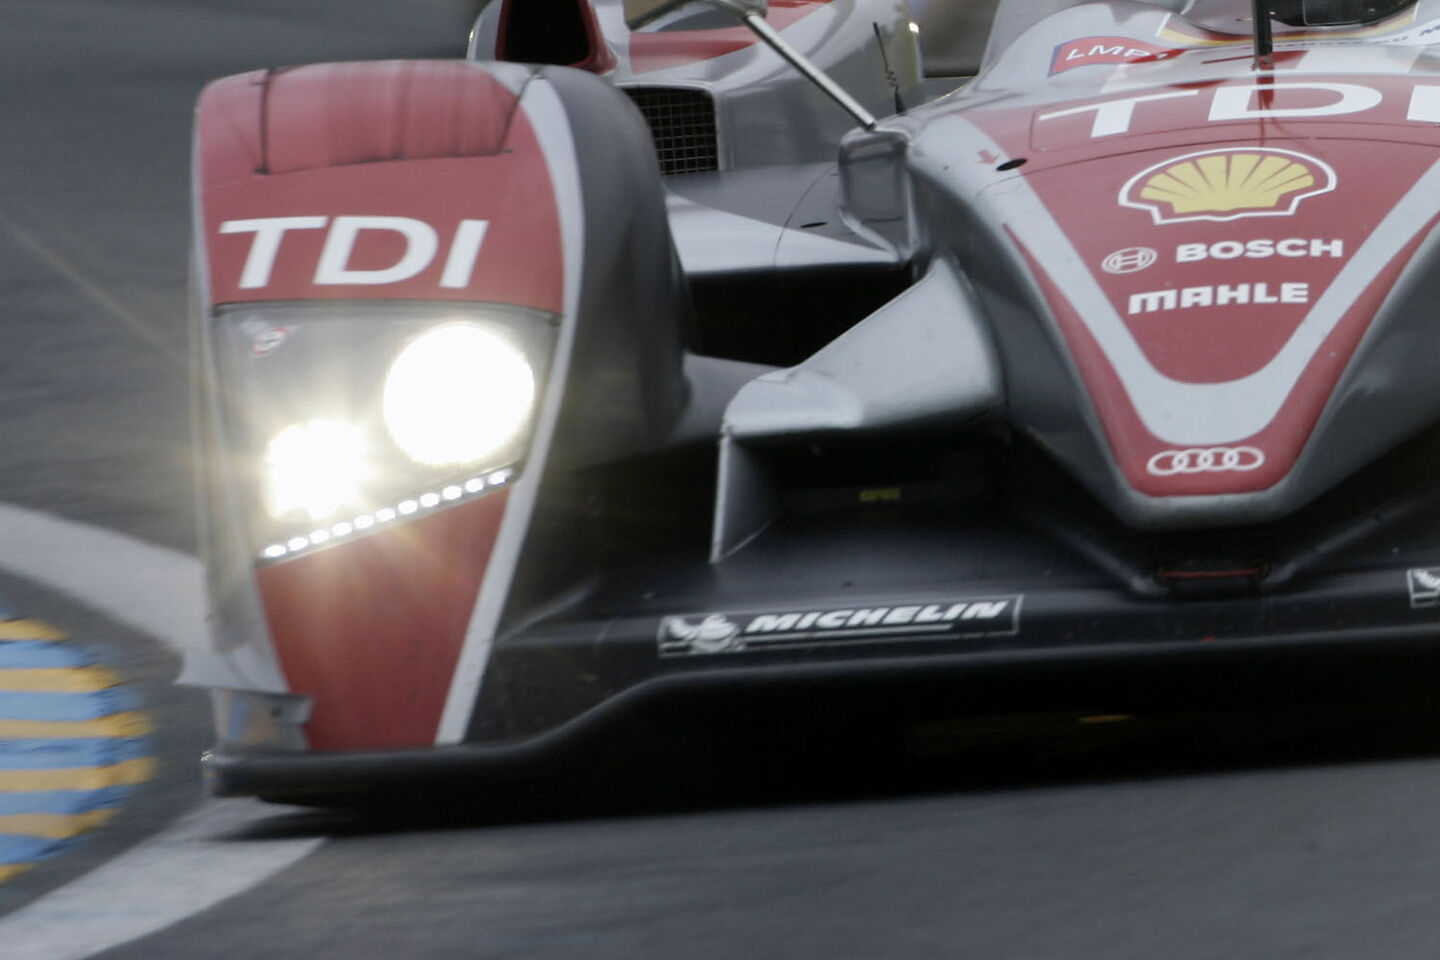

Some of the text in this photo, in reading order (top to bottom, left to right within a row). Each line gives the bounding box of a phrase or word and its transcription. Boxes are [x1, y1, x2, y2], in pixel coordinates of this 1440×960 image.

[218, 215, 489, 289] TDI
[1176, 238, 1343, 263] BOSCH
[1128, 282, 1309, 315] MAHLE
[744, 600, 1008, 633] MICHELIN
